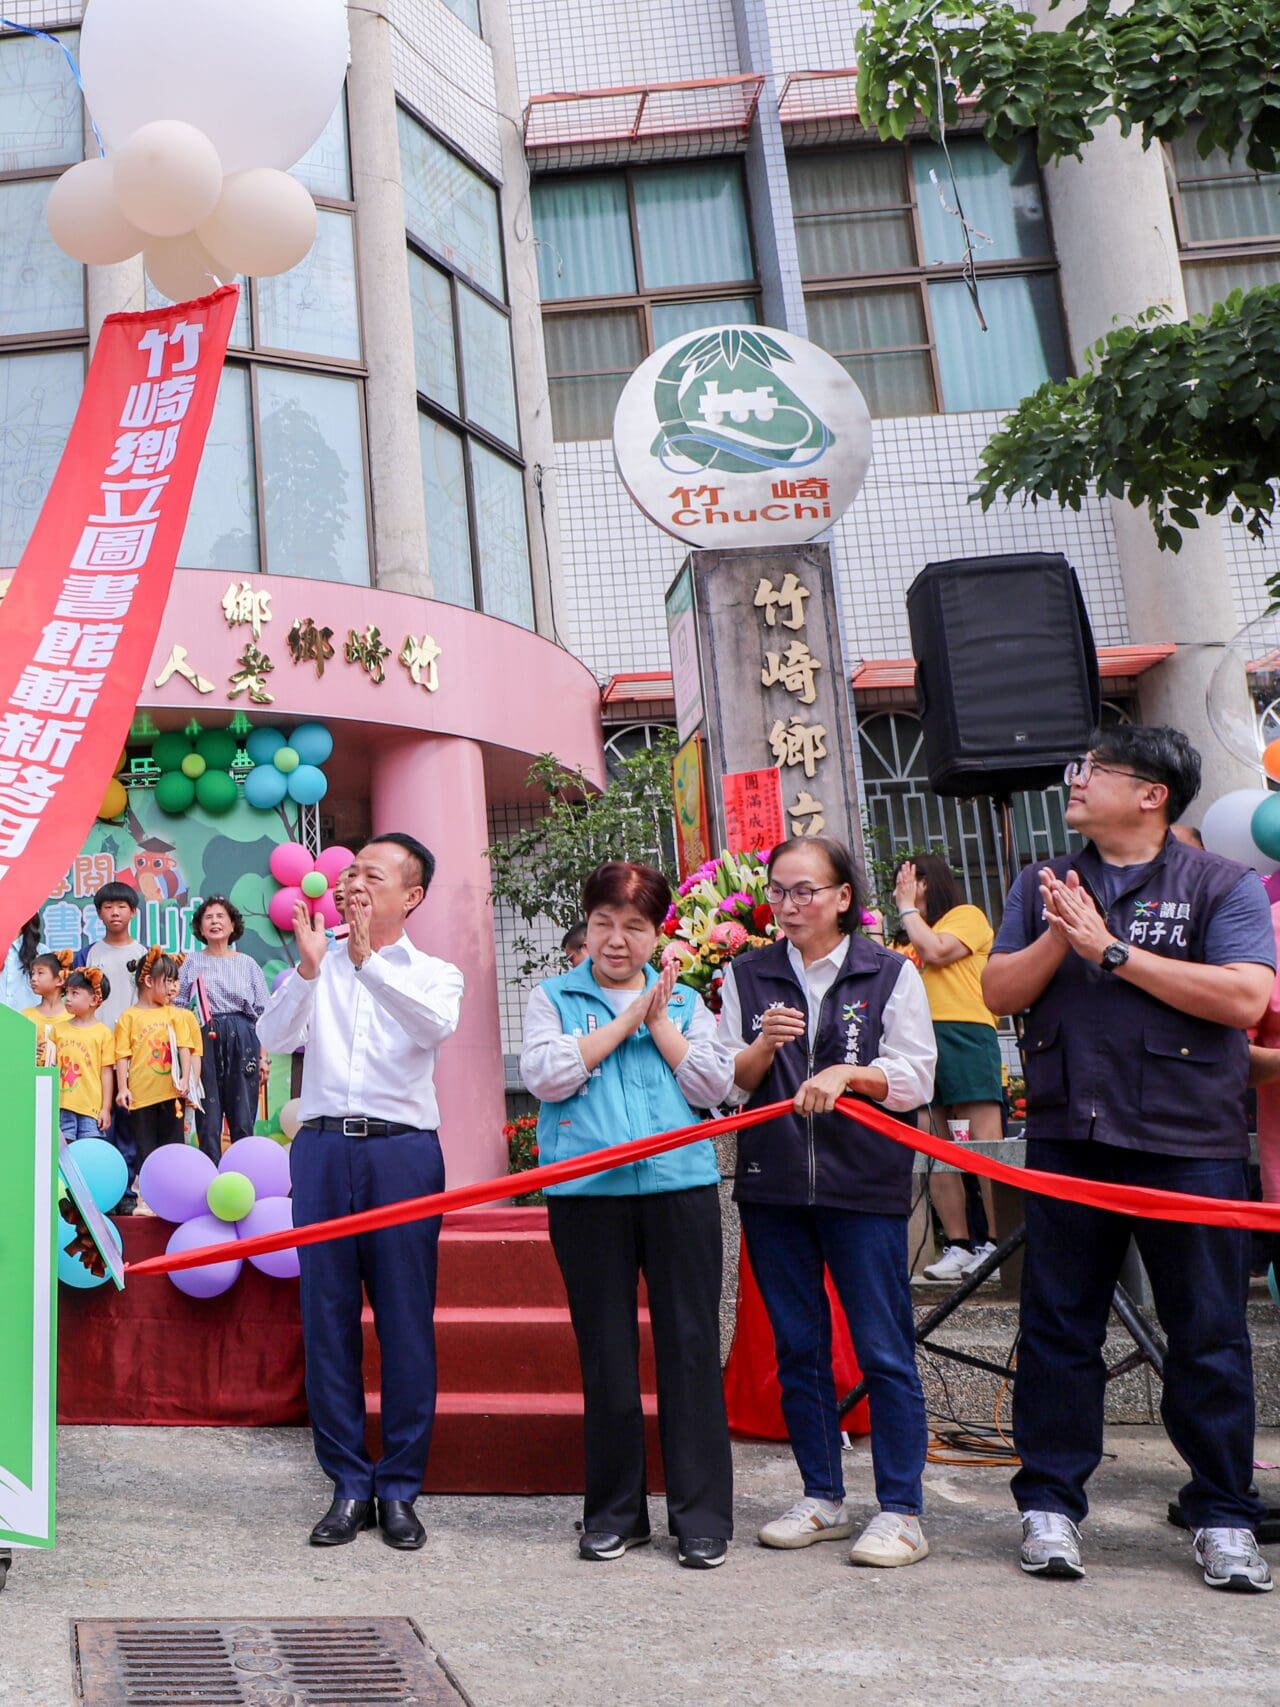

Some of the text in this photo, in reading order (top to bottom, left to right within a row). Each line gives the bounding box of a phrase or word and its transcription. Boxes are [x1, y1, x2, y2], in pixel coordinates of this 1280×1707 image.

[668, 478, 830, 508] 竹崎
[671, 502, 831, 526] ChuChi
[753, 573, 827, 837] 竹崎鄉立
[1159, 902, 1190, 920] 議員
[1129, 920, 1187, 947] 何子凡
